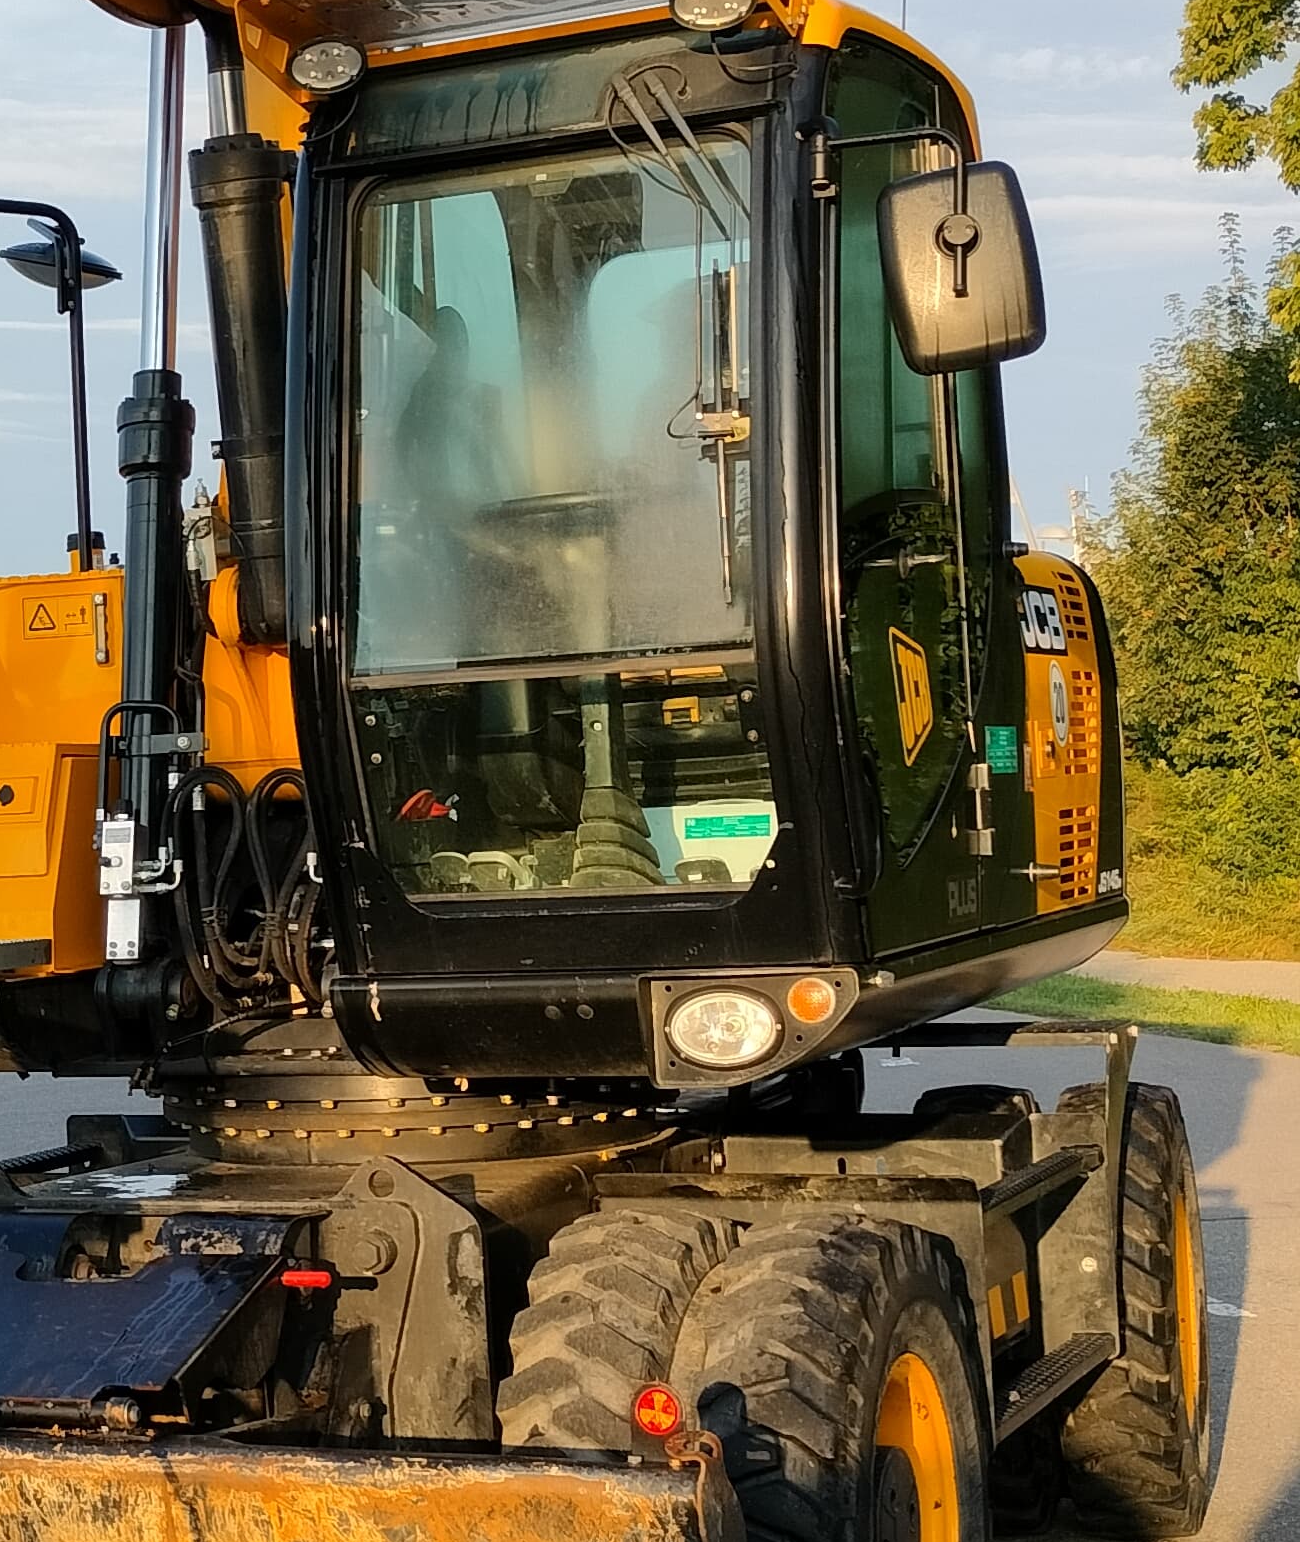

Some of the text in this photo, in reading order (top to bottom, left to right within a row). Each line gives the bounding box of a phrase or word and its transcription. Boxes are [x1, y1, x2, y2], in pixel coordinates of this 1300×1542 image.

[1020, 590, 1066, 650] JCB
[895, 642, 931, 750] JCB
[1053, 681, 1066, 724] 20
